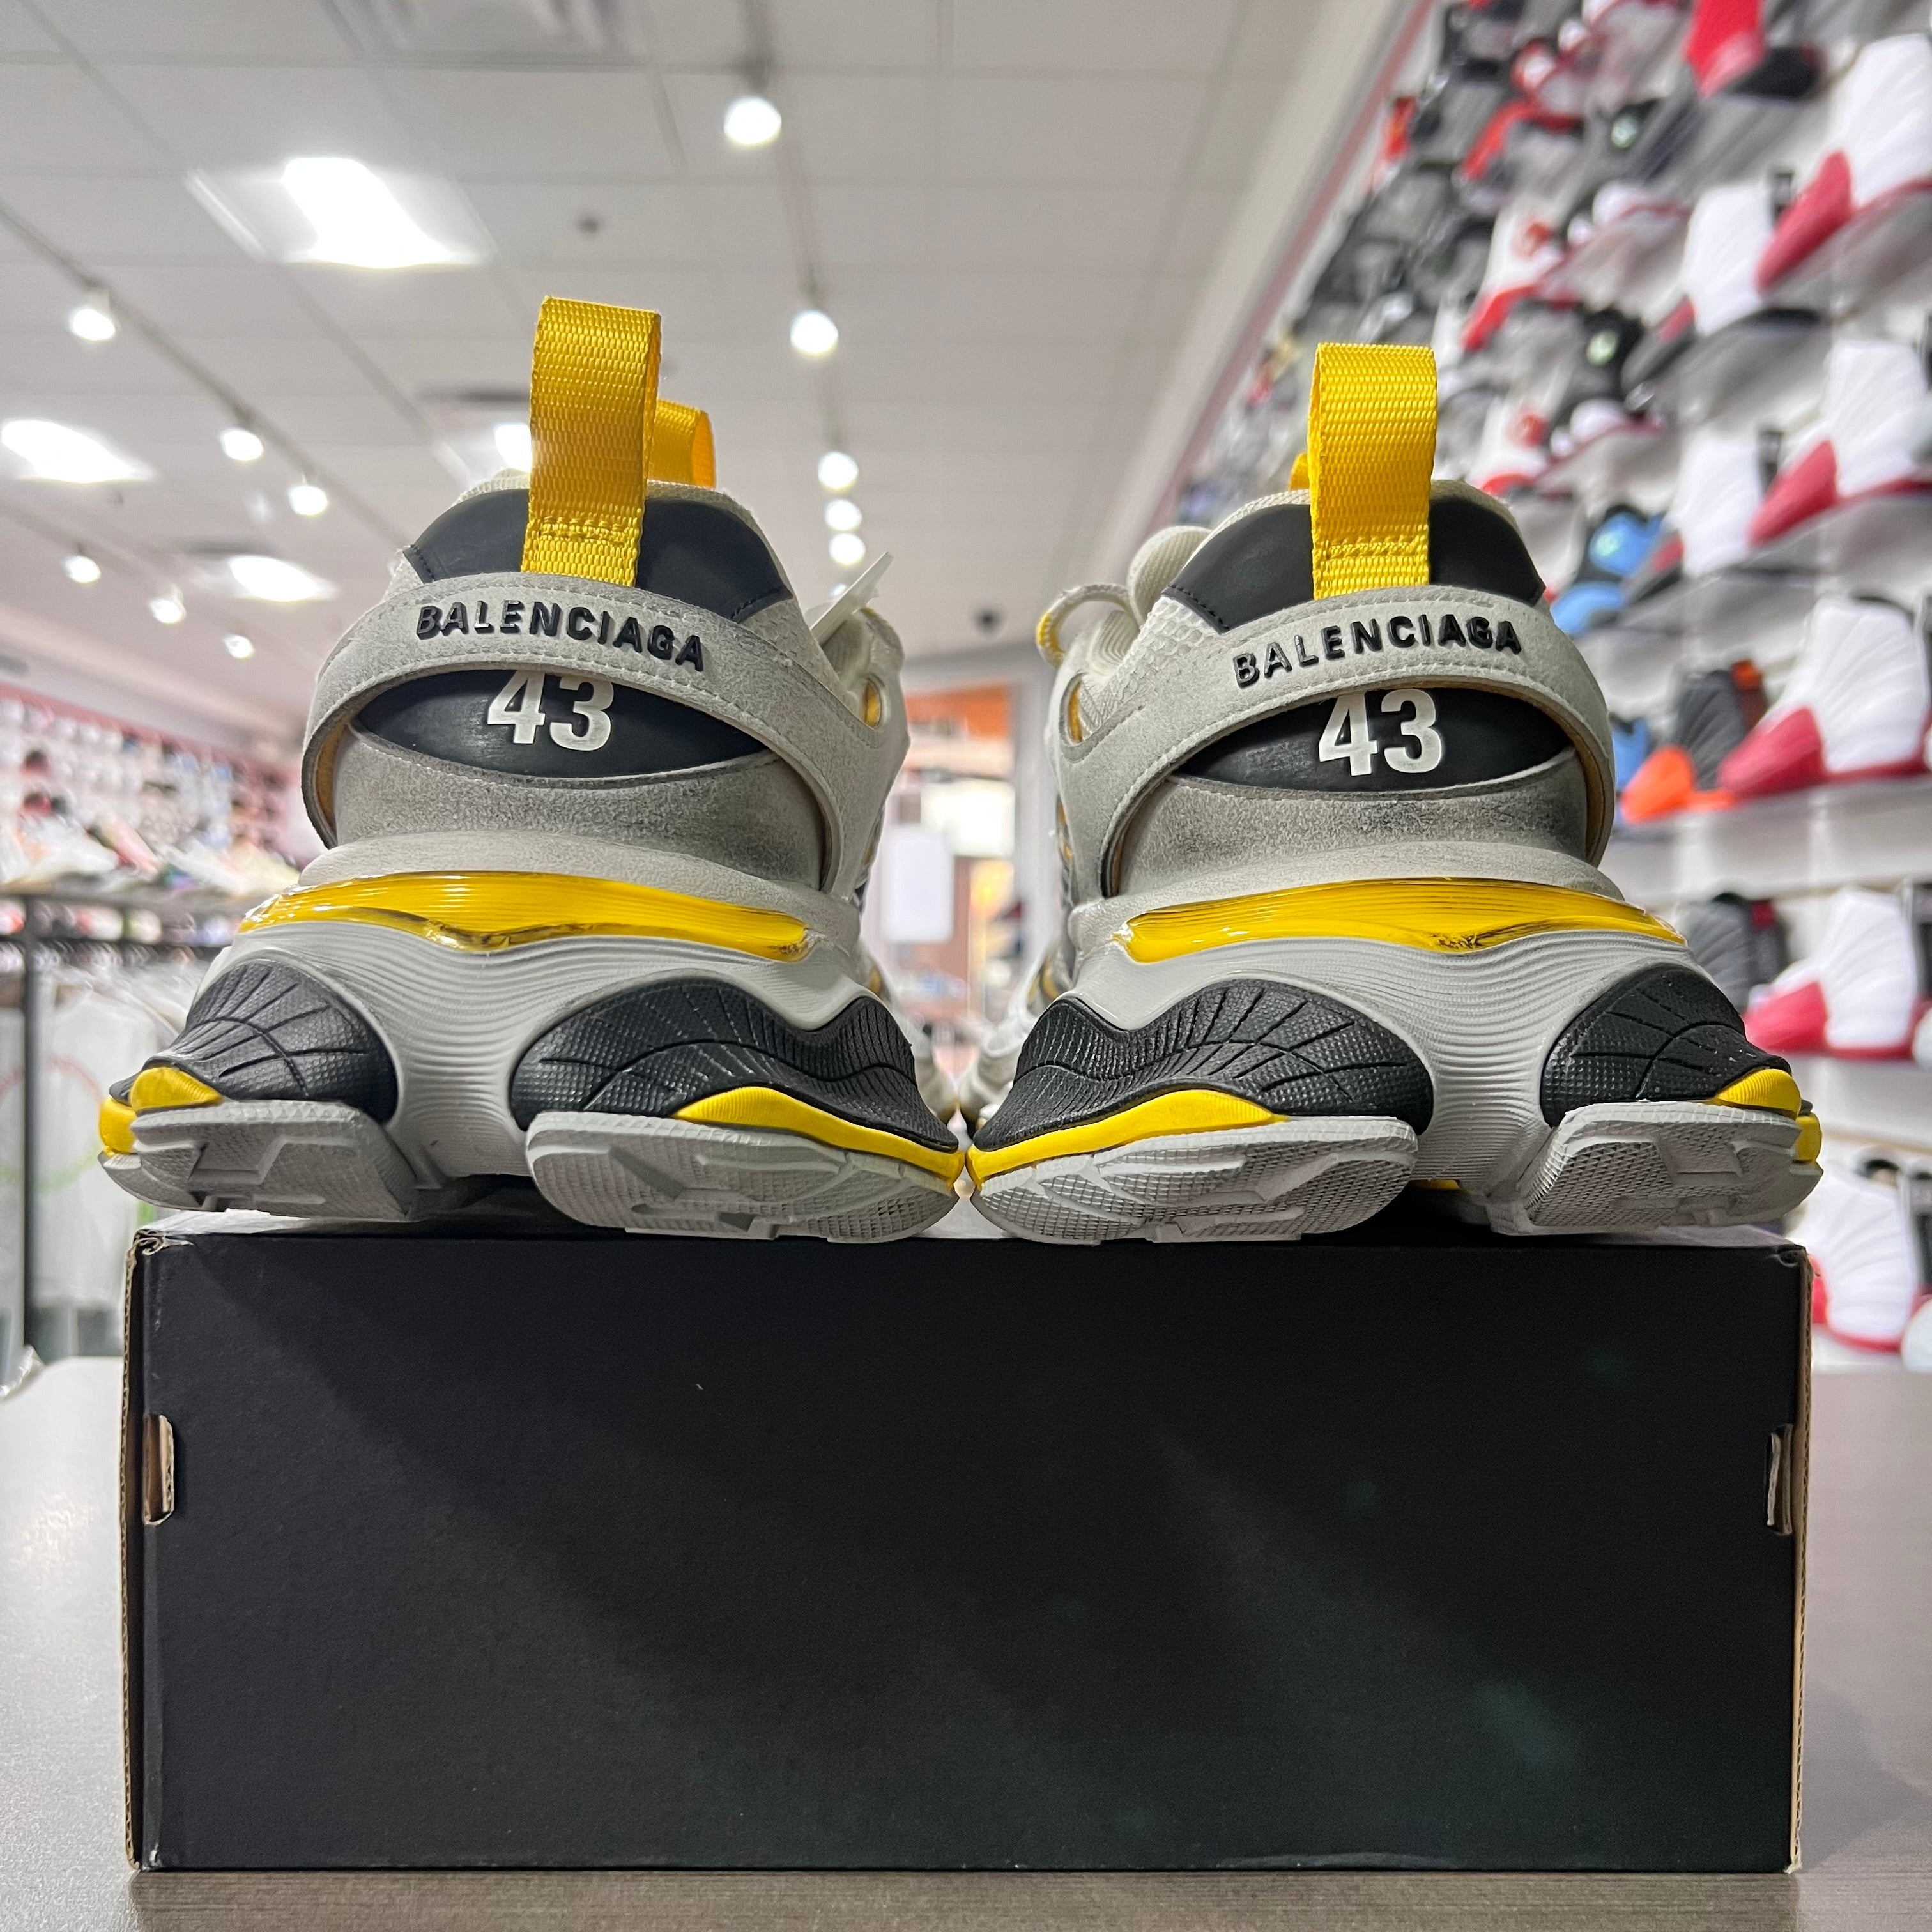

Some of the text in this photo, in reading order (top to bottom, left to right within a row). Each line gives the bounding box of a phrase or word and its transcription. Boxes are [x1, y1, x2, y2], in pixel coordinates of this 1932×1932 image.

[416, 599, 703, 671] BALENCIAGA
[1232, 614, 1521, 687] BALENCIAGA
[487, 670, 614, 751] 43
[1319, 689, 1442, 776] 43
